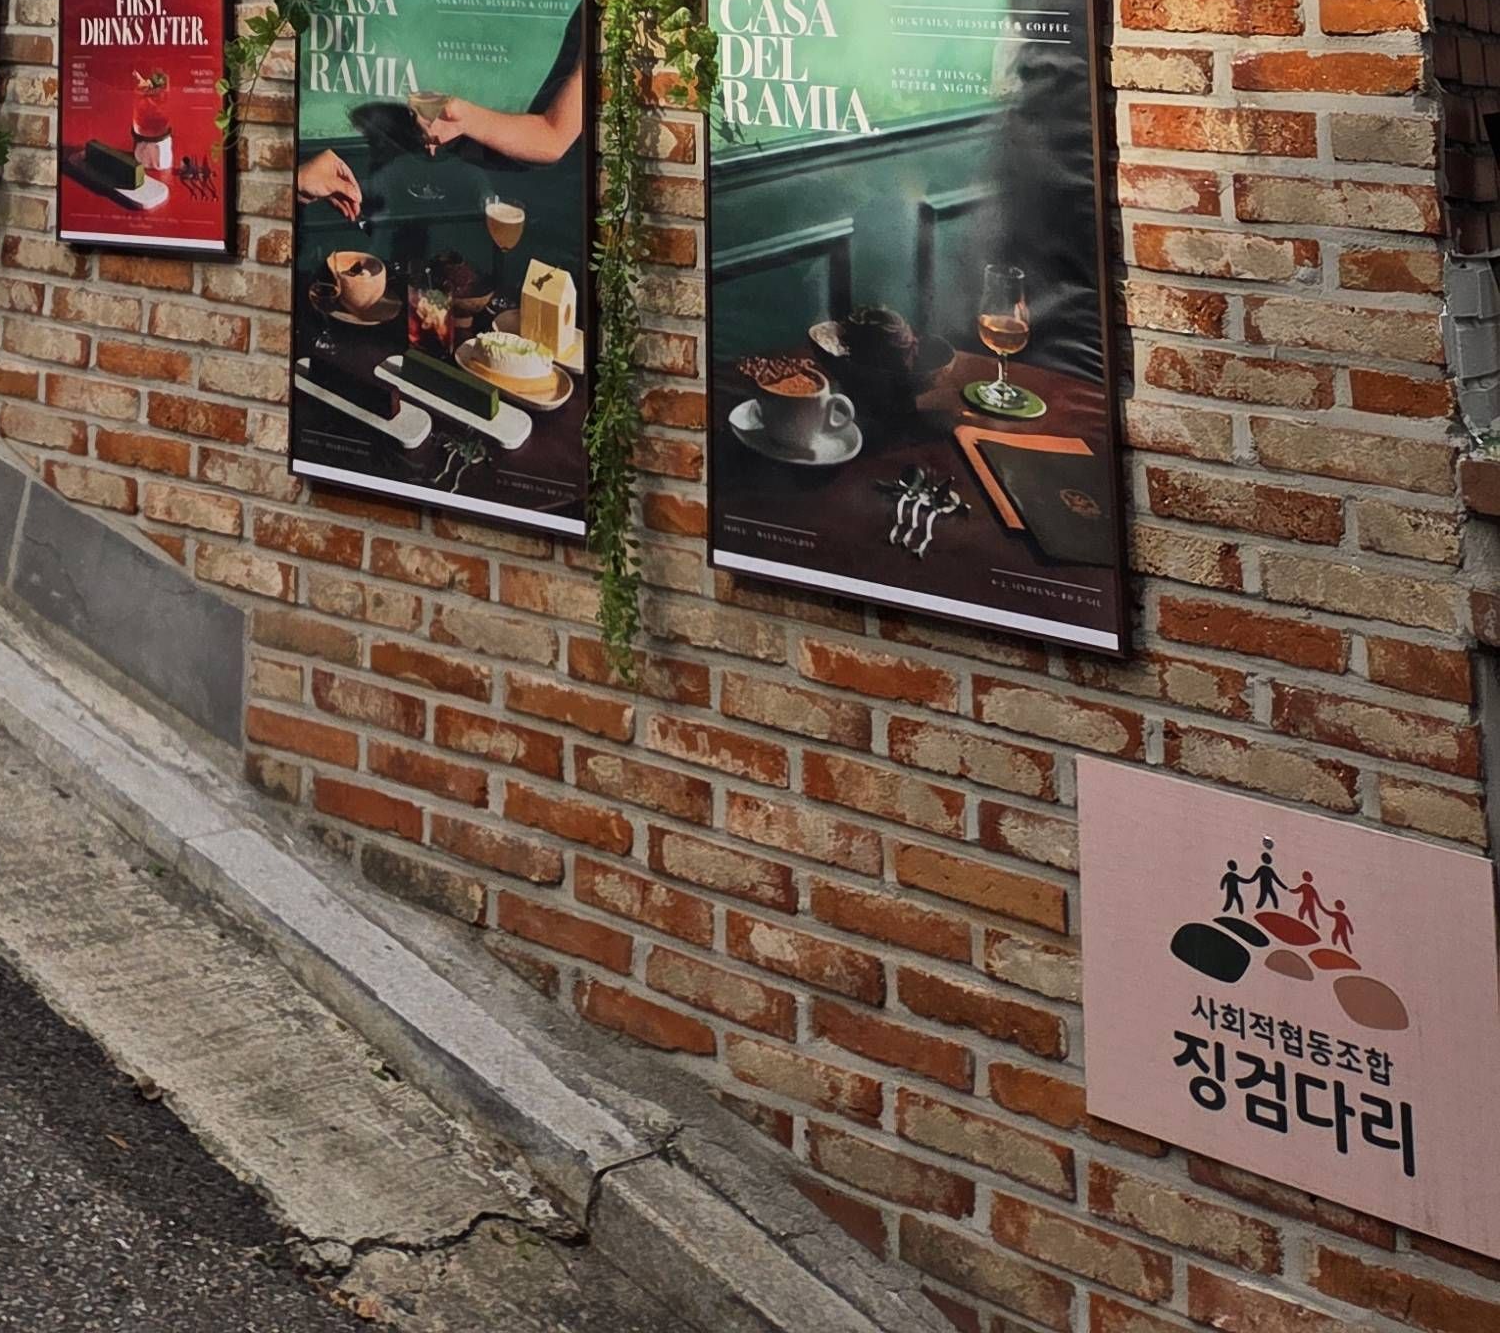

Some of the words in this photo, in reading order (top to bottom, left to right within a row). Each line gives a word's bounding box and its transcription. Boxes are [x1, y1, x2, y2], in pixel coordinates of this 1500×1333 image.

[80, 16, 144, 46] DRINKS
[147, 16, 209, 45] AFTER.
[310, 12, 376, 55] DEL
[1026, 22, 1070, 33] COFFEE
[718, 34, 808, 82] DEL
[1191, 995, 1394, 1086] 사회적협동조합
[1173, 1030, 1415, 1177] 징검다리
